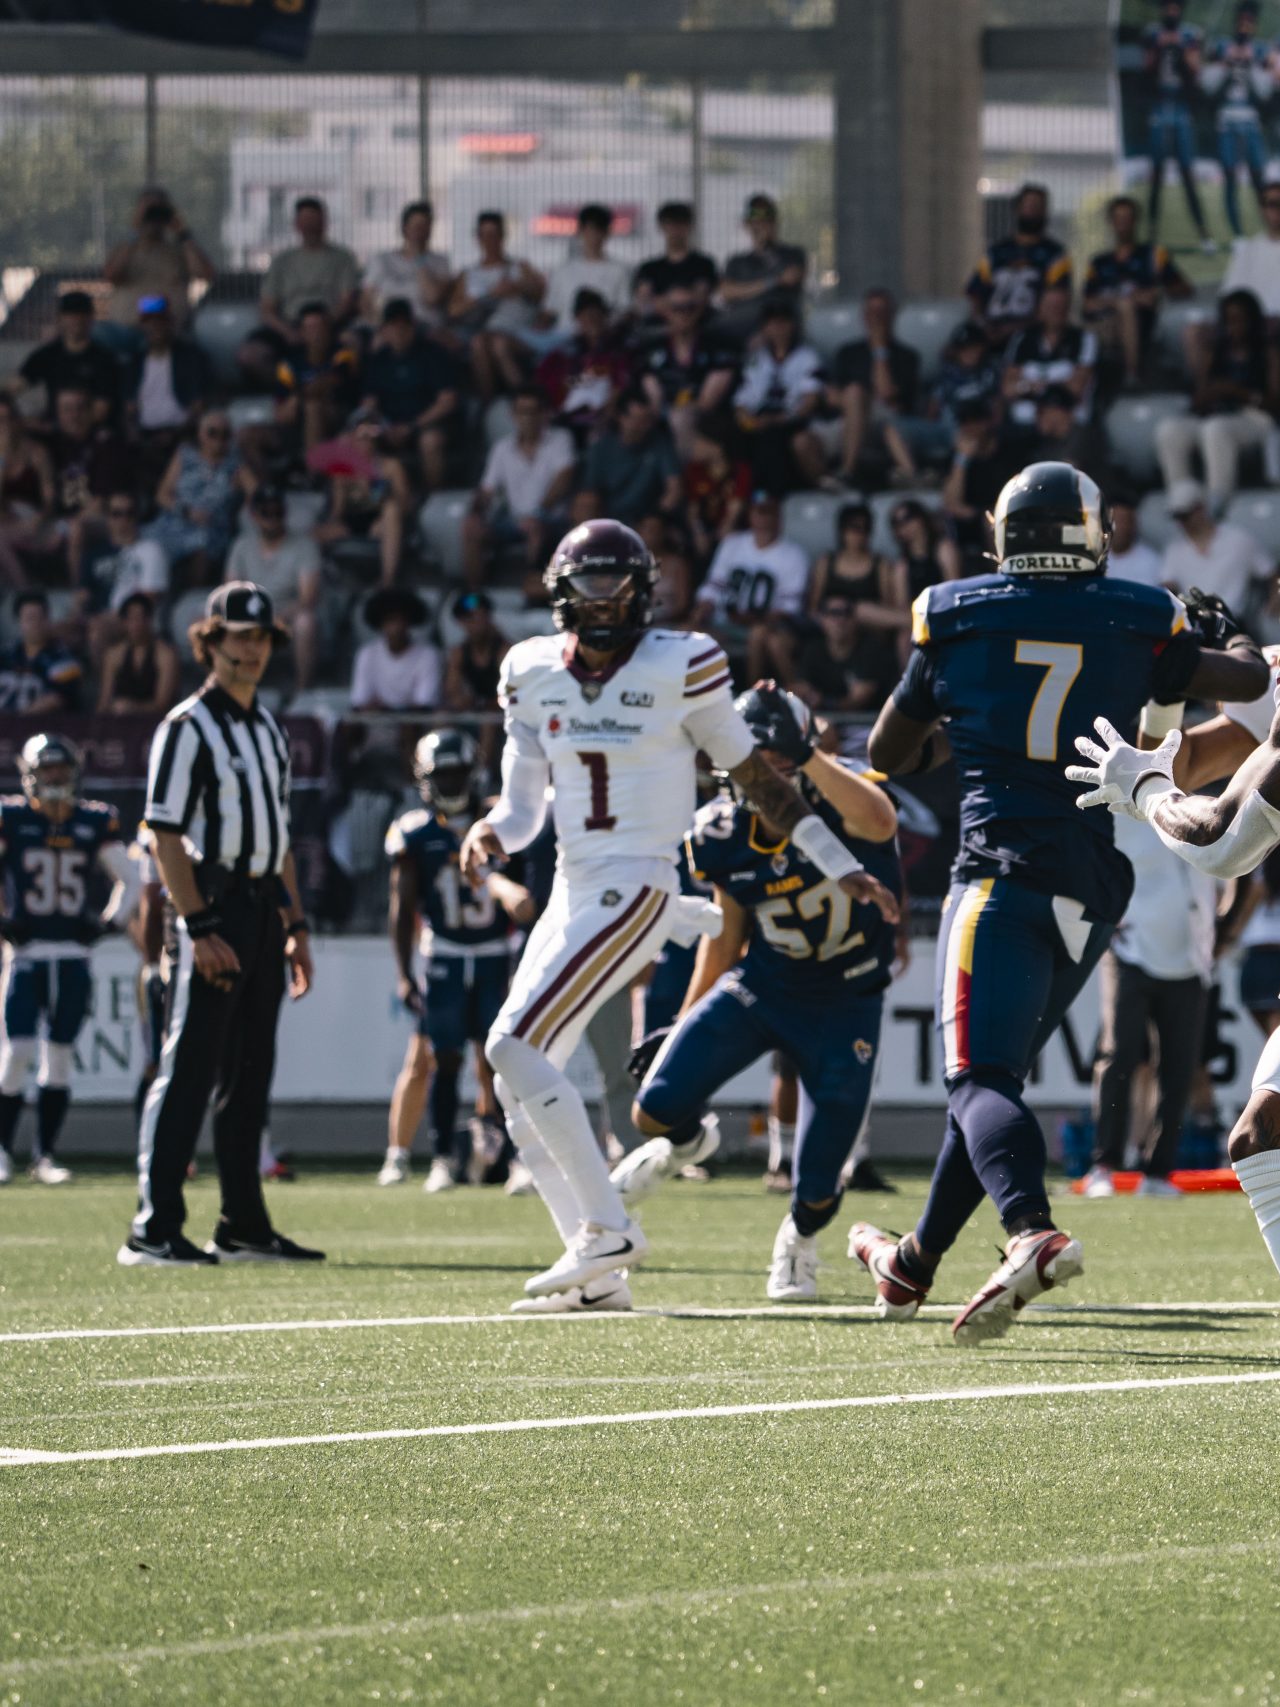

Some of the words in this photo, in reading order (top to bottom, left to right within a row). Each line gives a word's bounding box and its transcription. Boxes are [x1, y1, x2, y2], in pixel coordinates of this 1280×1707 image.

[1009, 556, 1082, 571] FORELLE
[1014, 639, 1083, 762] 7
[576, 751, 617, 832] 1
[23, 847, 87, 917] 35
[754, 878, 866, 963] 52
